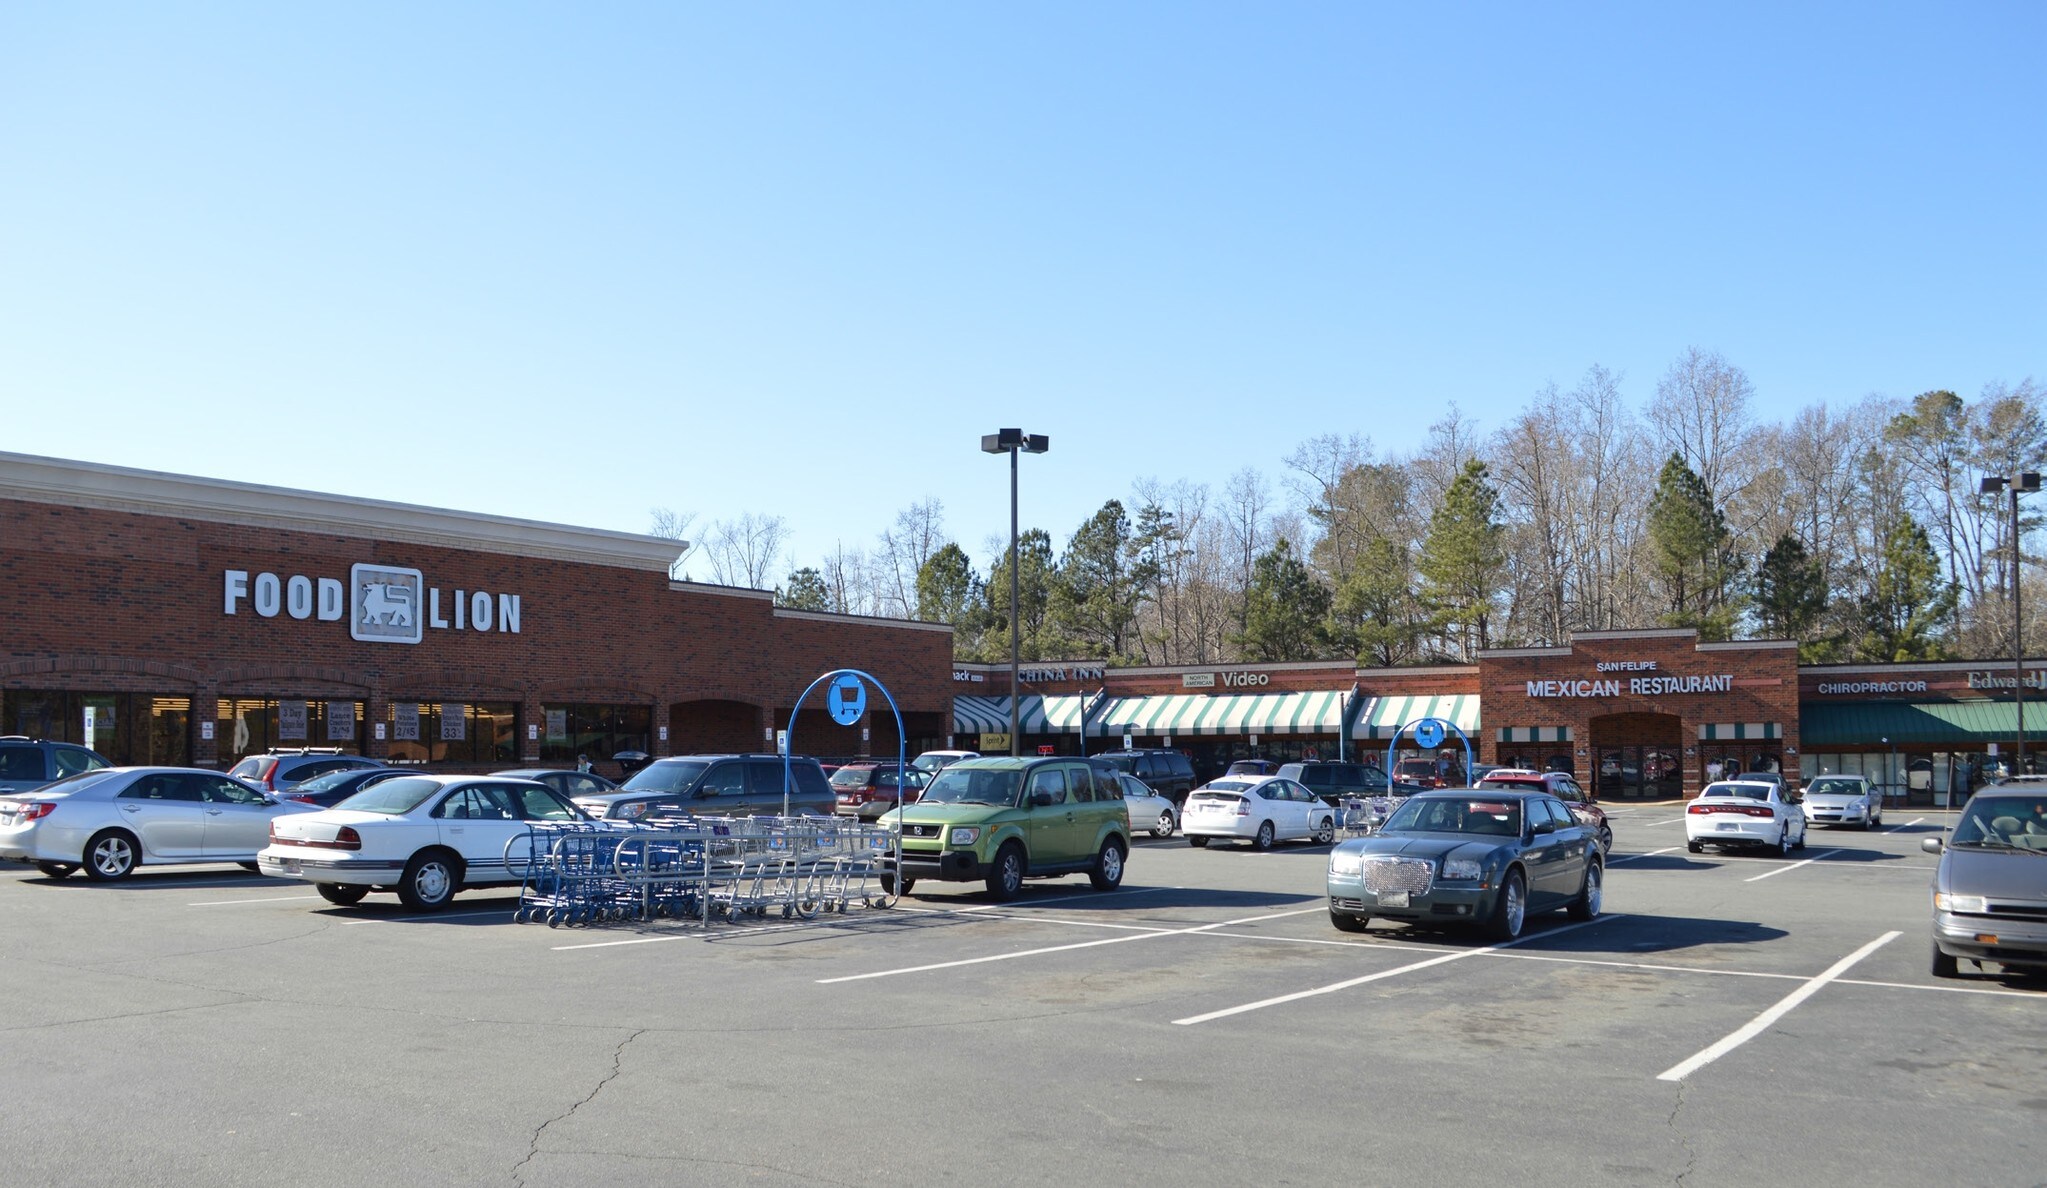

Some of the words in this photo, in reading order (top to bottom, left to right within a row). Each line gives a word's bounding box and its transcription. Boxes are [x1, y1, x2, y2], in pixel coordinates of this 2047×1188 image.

[224, 569, 343, 621] FOOD
[429, 587, 520, 633] LION
[1018, 668, 1066, 683] CHINA
[1073, 667, 1103, 681] INN
[1221, 672, 1269, 687] Video
[1526, 680, 1619, 697] MEXICAN
[1630, 675, 1733, 695] RESTAURANT
[1818, 681, 1927, 694] CHIROPRACTOR
[289, 708, 302, 719] Day
[986, 737, 1000, 745] Sprint
